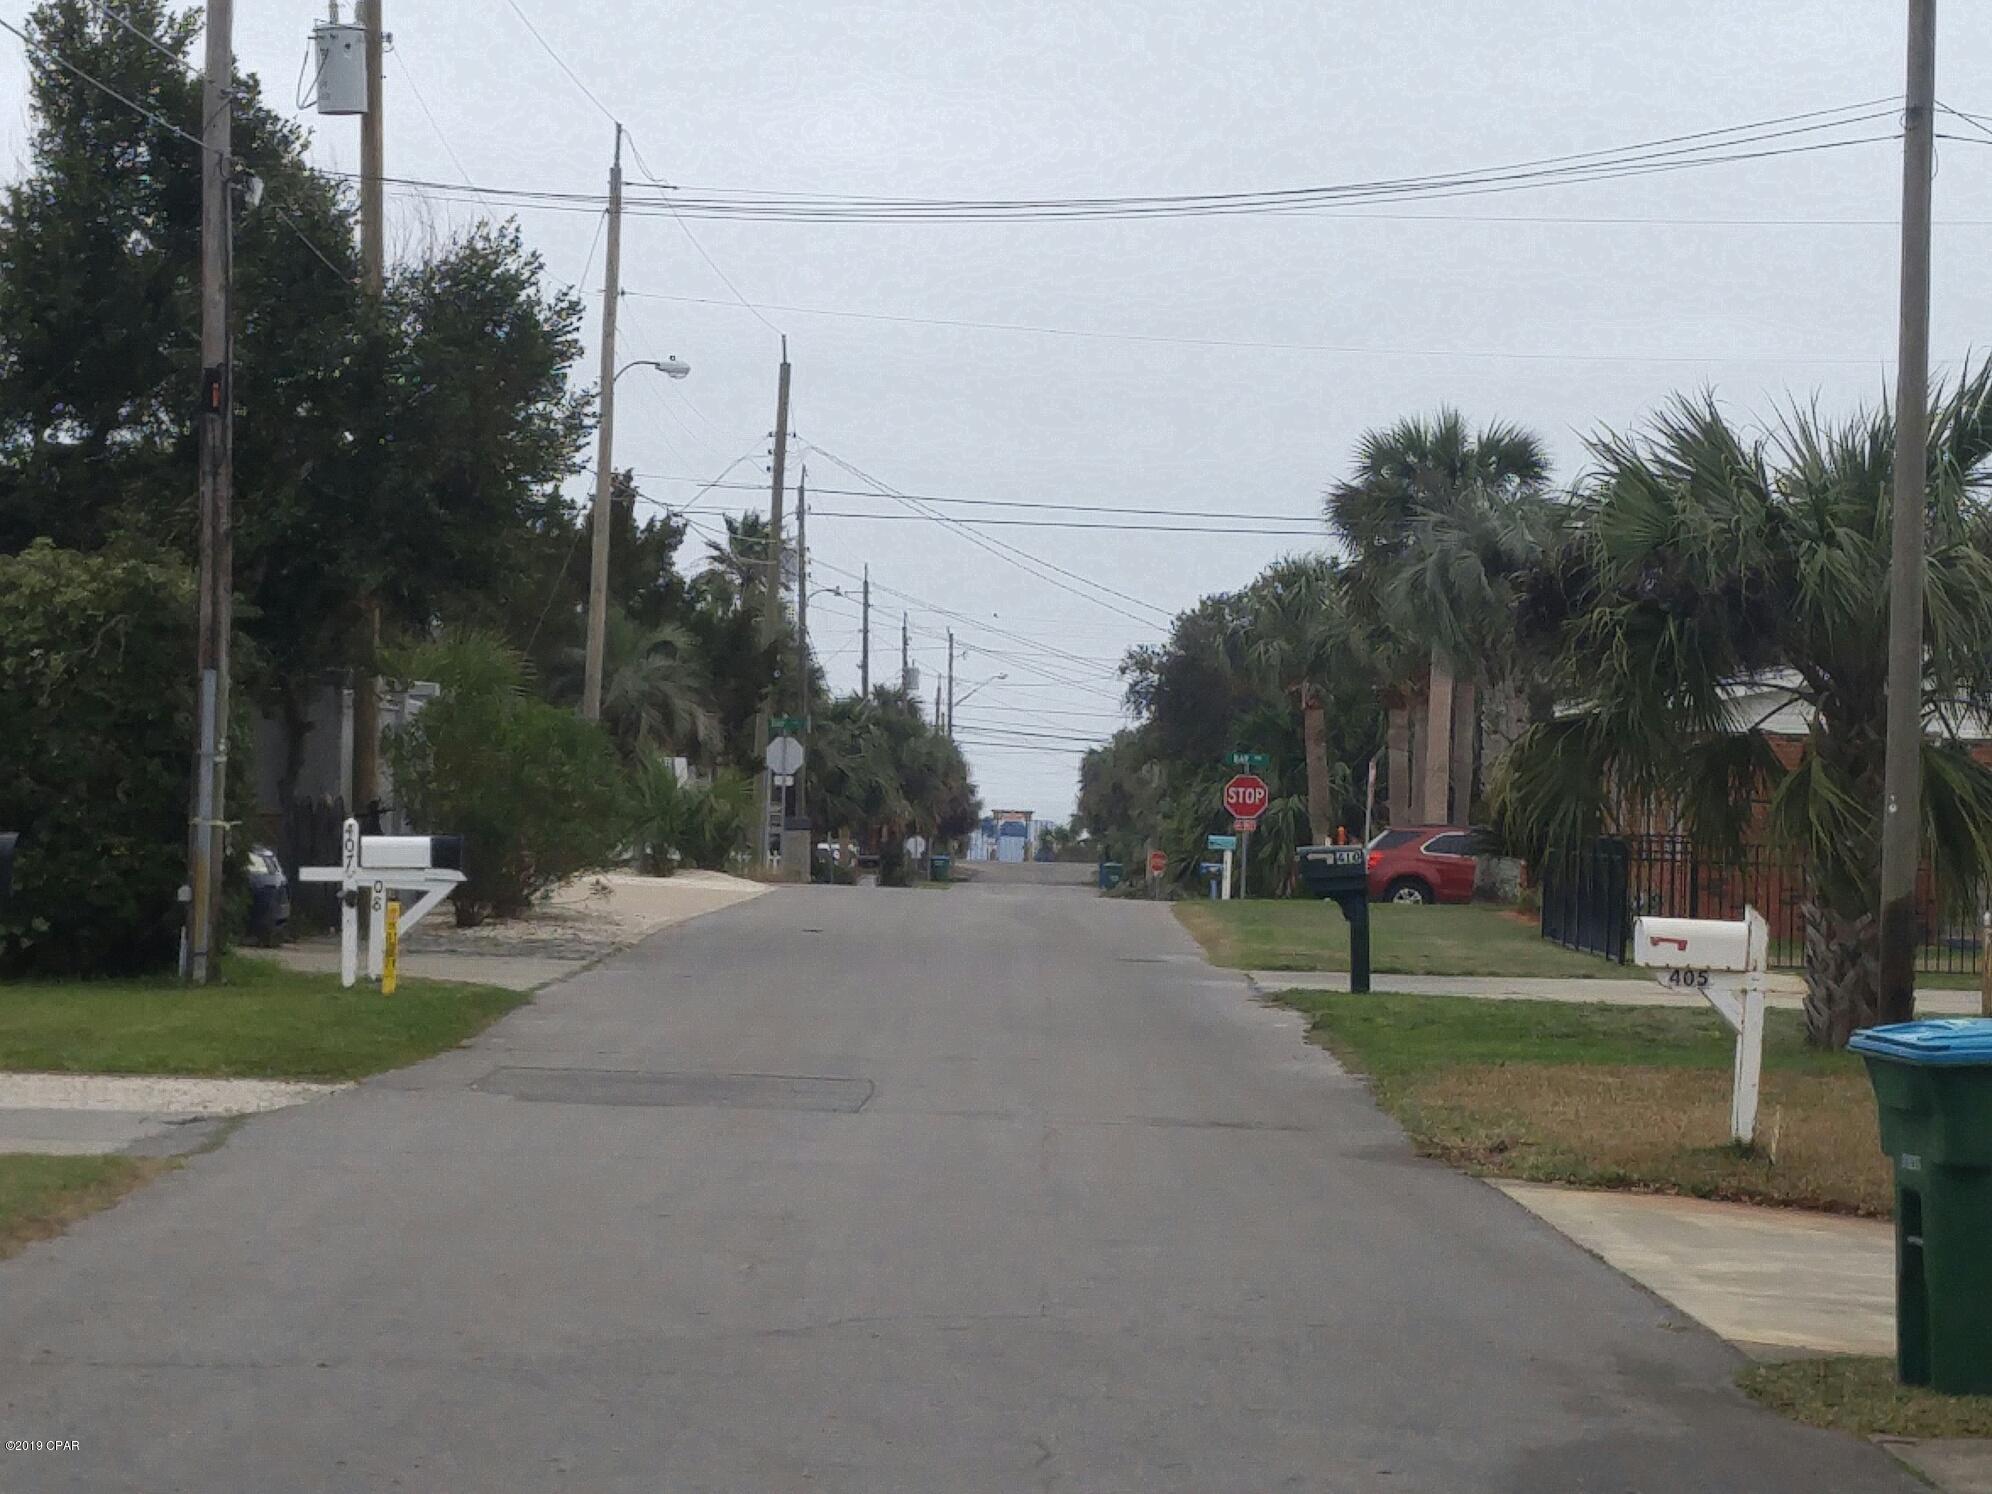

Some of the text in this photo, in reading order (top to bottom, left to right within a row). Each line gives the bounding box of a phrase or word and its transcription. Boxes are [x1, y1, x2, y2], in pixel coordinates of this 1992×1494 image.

[1228, 787, 1265, 804] STOP
[344, 823, 355, 874] 407
[1669, 968, 1708, 986] 405
